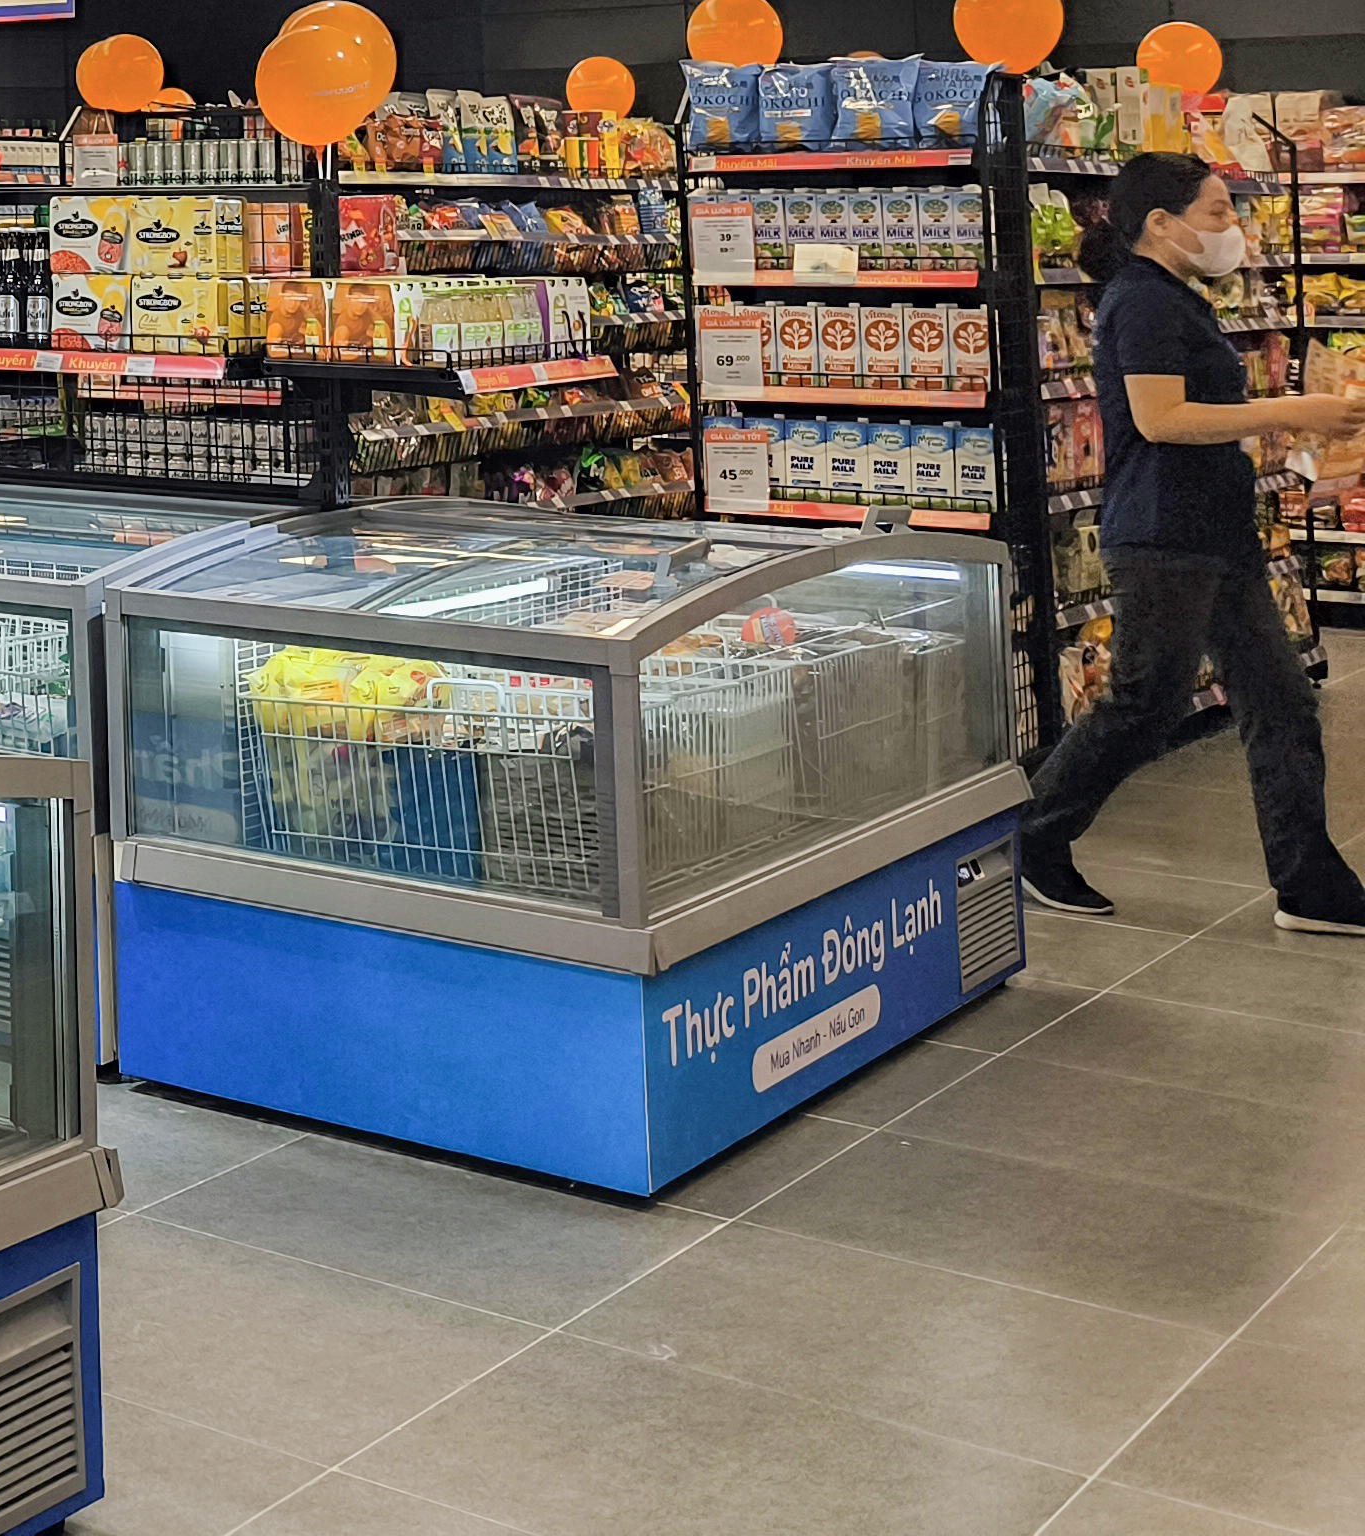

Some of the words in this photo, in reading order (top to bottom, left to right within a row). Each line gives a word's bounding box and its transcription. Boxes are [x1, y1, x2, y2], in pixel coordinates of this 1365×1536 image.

[789, 228, 814, 238] MILK
[821, 228, 846, 239] MILK
[923, 227, 950, 238] MILK
[69, 357, 117, 370] Khuyến
[790, 455, 814, 464] PURE
[832, 457, 856, 465] PURE
[874, 460, 898, 468] PURE
[790, 463, 814, 471] MILK
[832, 465, 856, 473] MILK
[916, 463, 940, 471] PURE
[663, 992, 735, 1066] Thực
[743, 942, 815, 1028] Phẩm
[821, 915, 885, 985] Đông
[891, 878, 941, 955] Lạnh
[771, 1048, 791, 1073] Mua
[792, 1031, 821, 1056] Nhanh
[829, 1014, 847, 1038] Nấu
[848, 1007, 865, 1031] Gọn
